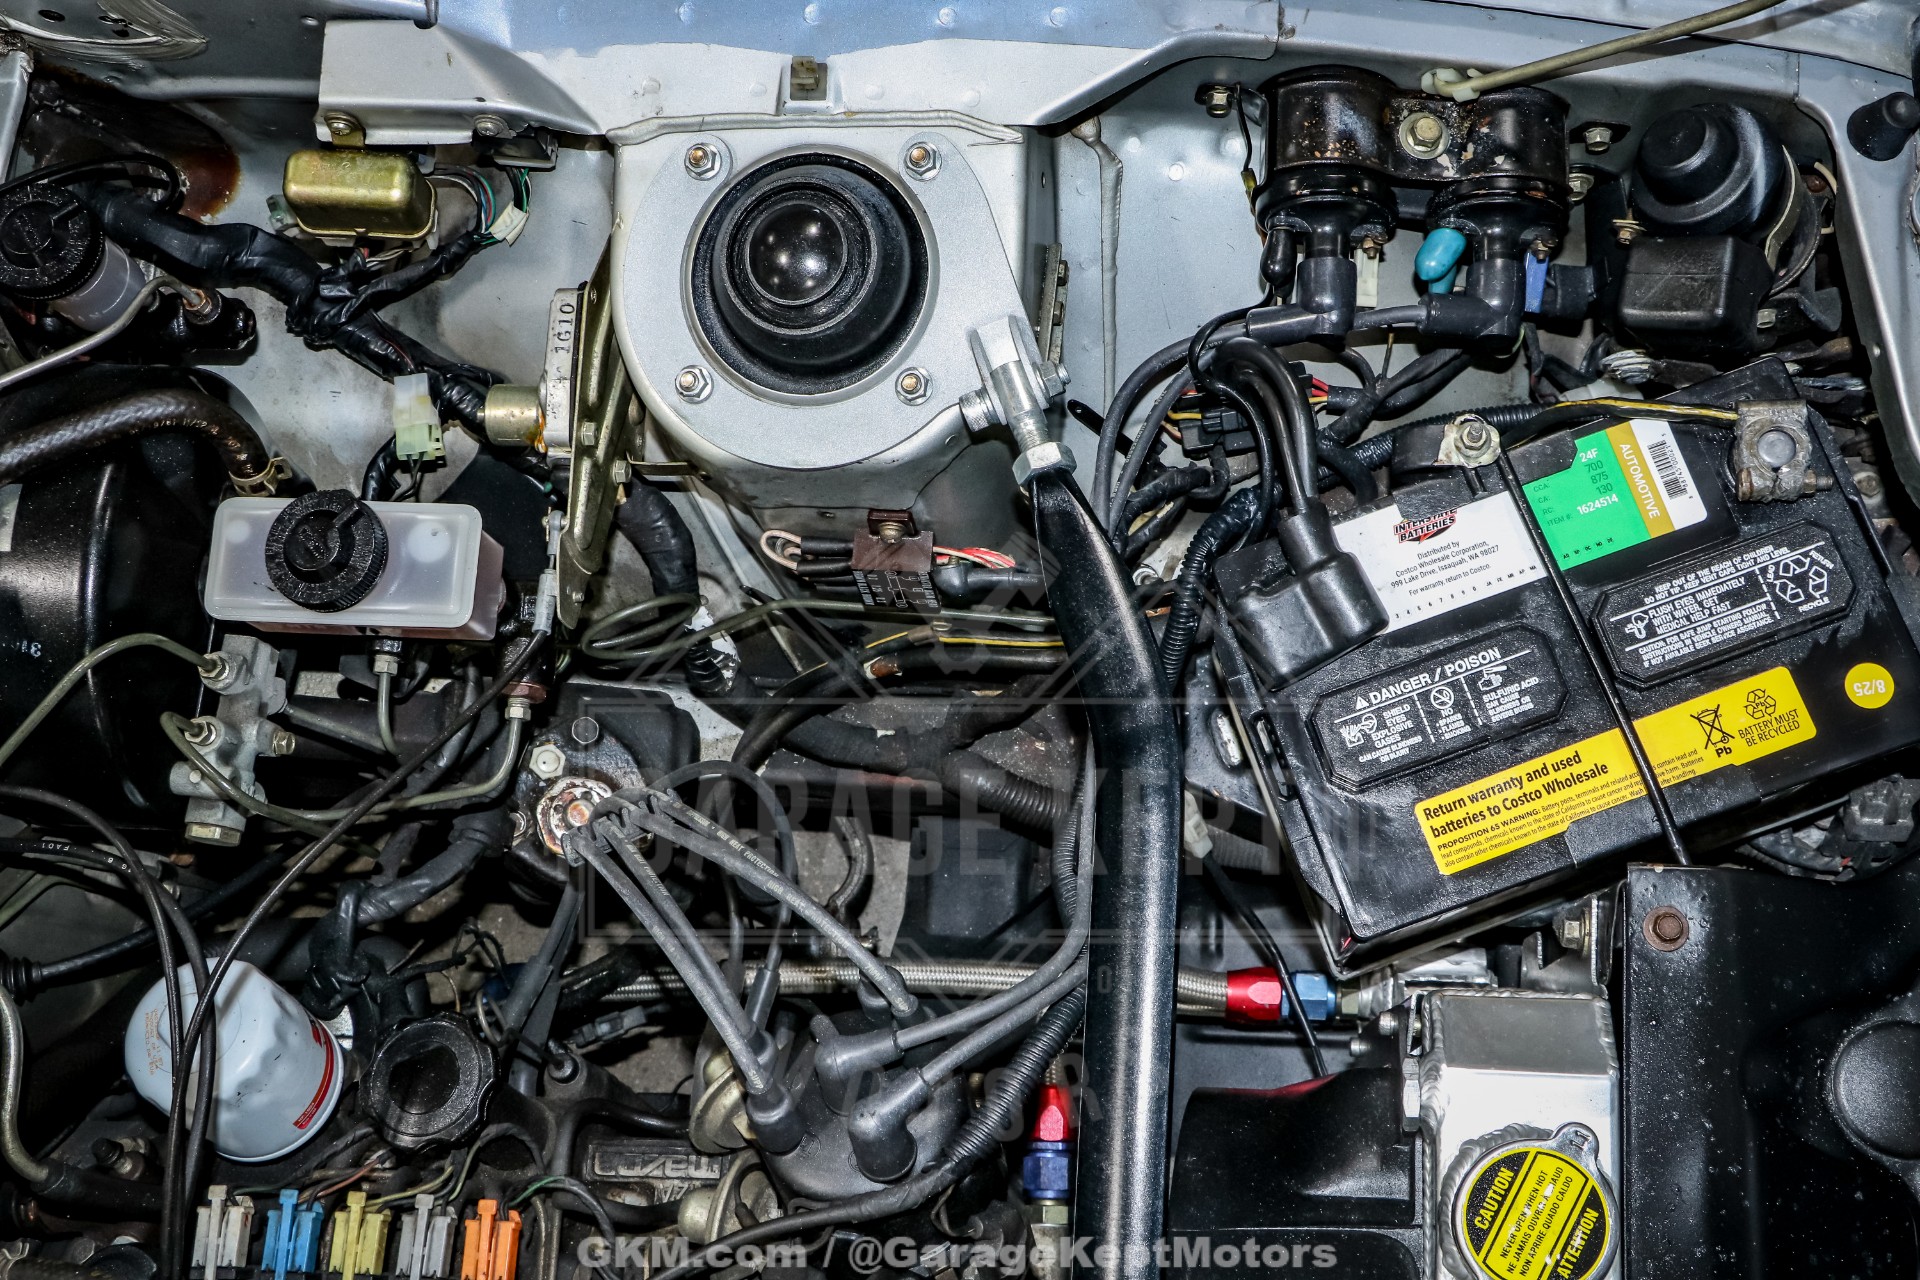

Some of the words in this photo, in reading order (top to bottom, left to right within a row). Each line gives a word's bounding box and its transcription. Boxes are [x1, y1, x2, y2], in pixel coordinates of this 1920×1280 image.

[1580, 449, 1600, 463] 24F
[1534, 482, 1550, 493] CCA:
[1586, 460, 1604, 474] 700
[1538, 496, 1550, 504] CA:
[1591, 472, 1609, 485] 875
[1596, 483, 1614, 496] 130
[1619, 444, 1660, 518] AUTOMOTIVE
[1548, 516, 1565, 527] ITEM
[1577, 494, 1618, 516] 1624514
[1399, 517, 1456, 542] BATTERIES
[1396, 565, 1418, 578] Costco
[1419, 553, 1451, 569] Wholesale
[1451, 540, 1490, 559] Corporation,
[1417, 544, 1452, 560] Distributed
[1452, 540, 1461, 550] by
[1809, 550, 1835, 570] RETURN
[1391, 579, 1403, 589] 999
[1404, 574, 1419, 584] Lake
[1420, 568, 1438, 579] Drive,
[1438, 557, 1468, 573] Issaquah,
[1468, 552, 1480, 561] WA
[1480, 545, 1500, 557] 98027
[1409, 588, 1419, 596] For
[1420, 579, 1445, 593] warranty,
[1446, 573, 1463, 583] return
[1470, 563, 1492, 576] Costco.
[1644, 596, 1655, 605] DO
[1656, 592, 1669, 601] NOT
[1670, 586, 1683, 595] TIP.
[1684, 580, 1701, 591] KEEP
[1701, 574, 1719, 584] VENT
[1719, 567, 1737, 578] CAPS
[1738, 560, 1756, 571] TIGHT
[1757, 554, 1771, 564] AND
[1772, 547, 1790, 558] LEVEL
[1655, 582, 1672, 593] KEEP
[1672, 577, 1687, 587] OUT
[1687, 573, 1696, 581] OF
[1697, 568, 1710, 578] THE
[1711, 561, 1733, 573] REACH
[1743, 545, 1774, 561] CHILDREN
[1766, 566, 1776, 583] LEAD
[1649, 604, 1675, 619] FLUSH
[1675, 596, 1696, 609] EYES
[1696, 578, 1746, 601] IMMEDIATELY
[1653, 613, 1674, 627] WITH
[1703, 596, 1719, 608] GET
[1799, 597, 1830, 612] RECYCLE
[1656, 617, 1690, 635] MEDICAL
[1690, 609, 1711, 623] HELP
[1712, 602, 1732, 615] FAST
[1667, 636, 1680, 645] FOR
[1680, 630, 1695, 640] SAFE
[1696, 624, 1713, 634] JUMP
[1713, 614, 1741, 628] STARTING
[1743, 604, 1767, 617] FOLLOW
[1642, 641, 1685, 661] INSTRUCTIONS
[1693, 630, 1716, 643] VEHICLE
[1718, 621, 1742, 634] OWNERS
[1651, 656, 1664, 665] NOT
[1664, 646, 1695, 661] AVAILABLE
[1696, 640, 1711, 649] SEEK
[1712, 631, 1736, 643] SERVICE
[1369, 673, 1432, 704] DANGER
[1444, 647, 1502, 677] POISON
[1484, 684, 1522, 703] SULFURIC
[1522, 677, 1540, 689] ACID
[1853, 678, 1885, 696] 8/25
[1384, 705, 1411, 719] SHIELD
[1442, 708, 1454, 717] NO
[1489, 700, 1520, 716] BLINDNESS
[1500, 693, 1520, 704] CAUSE
[1372, 721, 1413, 740] EXPLOSIVE
[1387, 715, 1407, 727] EYES
[1738, 719, 1775, 739] BATTERY
[1774, 710, 1799, 725] MUST
[1746, 737, 1758, 747] BE
[1757, 721, 1801, 743] RECYCLED
[1375, 735, 1401, 749] GASES
[1716, 746, 1733, 758] Pb
[1424, 796, 1468, 821] Return
[1467, 775, 1526, 806] warranty
[1525, 763, 1550, 783] and
[1550, 751, 1582, 773] used
[1430, 808, 1488, 839] batteries
[1486, 802, 1502, 818] to
[1501, 787, 1543, 812] Costco
[1542, 761, 1610, 796] Wholesale
[1438, 828, 1490, 852] PROPOSITION
[1490, 824, 1501, 832] 65
[1501, 808, 1542, 828] WARNING:
[1542, 802, 1560, 814] Battery
[1561, 796, 1576, 807] posts,
[1576, 787, 1600, 800] terminals
[1601, 783, 1611, 791] and
[1611, 776, 1629, 787] related
[1658, 759, 1676, 770] contain
[1677, 754, 1687, 762] lead
[1444, 859, 1455, 868] also
[1456, 853, 1475, 864] contain
[1475, 847, 1489, 857] other
[1489, 837, 1514, 852] chemicals
[1515, 831, 1532, 842] known
[1547, 820, 1560, 829] state
[1565, 808, 1590, 821] California
[1596, 801, 1611, 810] cause
[1661, 778, 1673, 786] after
[1453, 839, 1484, 857] compounds,
[1484, 830, 1509, 844] chemicals
[1510, 823, 1527, 834] known
[1543, 812, 1555, 821] state
[1561, 801, 1585, 814] California
[1592, 794, 1605, 803] cause
[1606, 787, 1623, 797] cancer
[1474, 1167, 1514, 1230] CAUTION
[1500, 1234, 1517, 1258] NEVER
[1516, 1211, 1527, 1233] OPEN
[1526, 1186, 1540, 1211] WHEN
[1537, 1170, 1548, 1188] HOT
[1520, 1263, 1530, 1277] NON
[1530, 1233, 1547, 1260] APRIRE
[1542, 1204, 1560, 1230] QUADO
[1556, 1176, 1574, 1202] CALDO
[1506, 1263, 1517, 1274] NE
[1514, 1232, 1532, 1262] JAMAIS
[1557, 1208, 1599, 1280] ATTENTION
